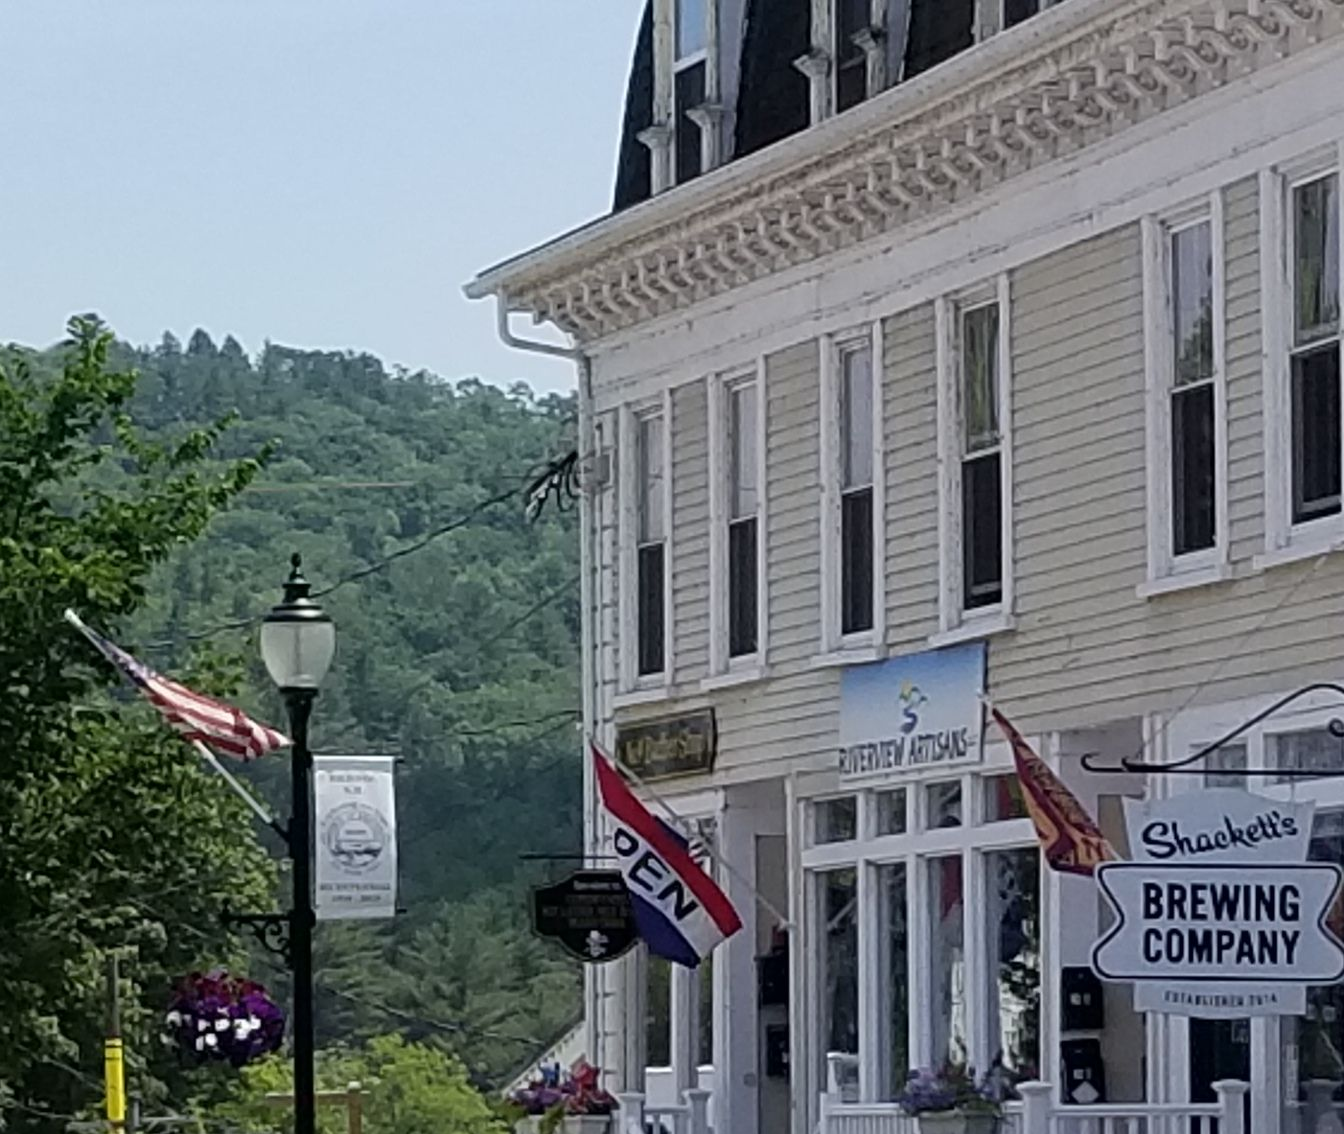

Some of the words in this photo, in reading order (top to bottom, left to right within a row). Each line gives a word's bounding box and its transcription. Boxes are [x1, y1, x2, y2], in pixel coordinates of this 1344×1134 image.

[1142, 809, 1299, 859] Shackett's
[1142, 882, 1301, 922] BREWING
[1142, 928, 1301, 965] COMPANY
